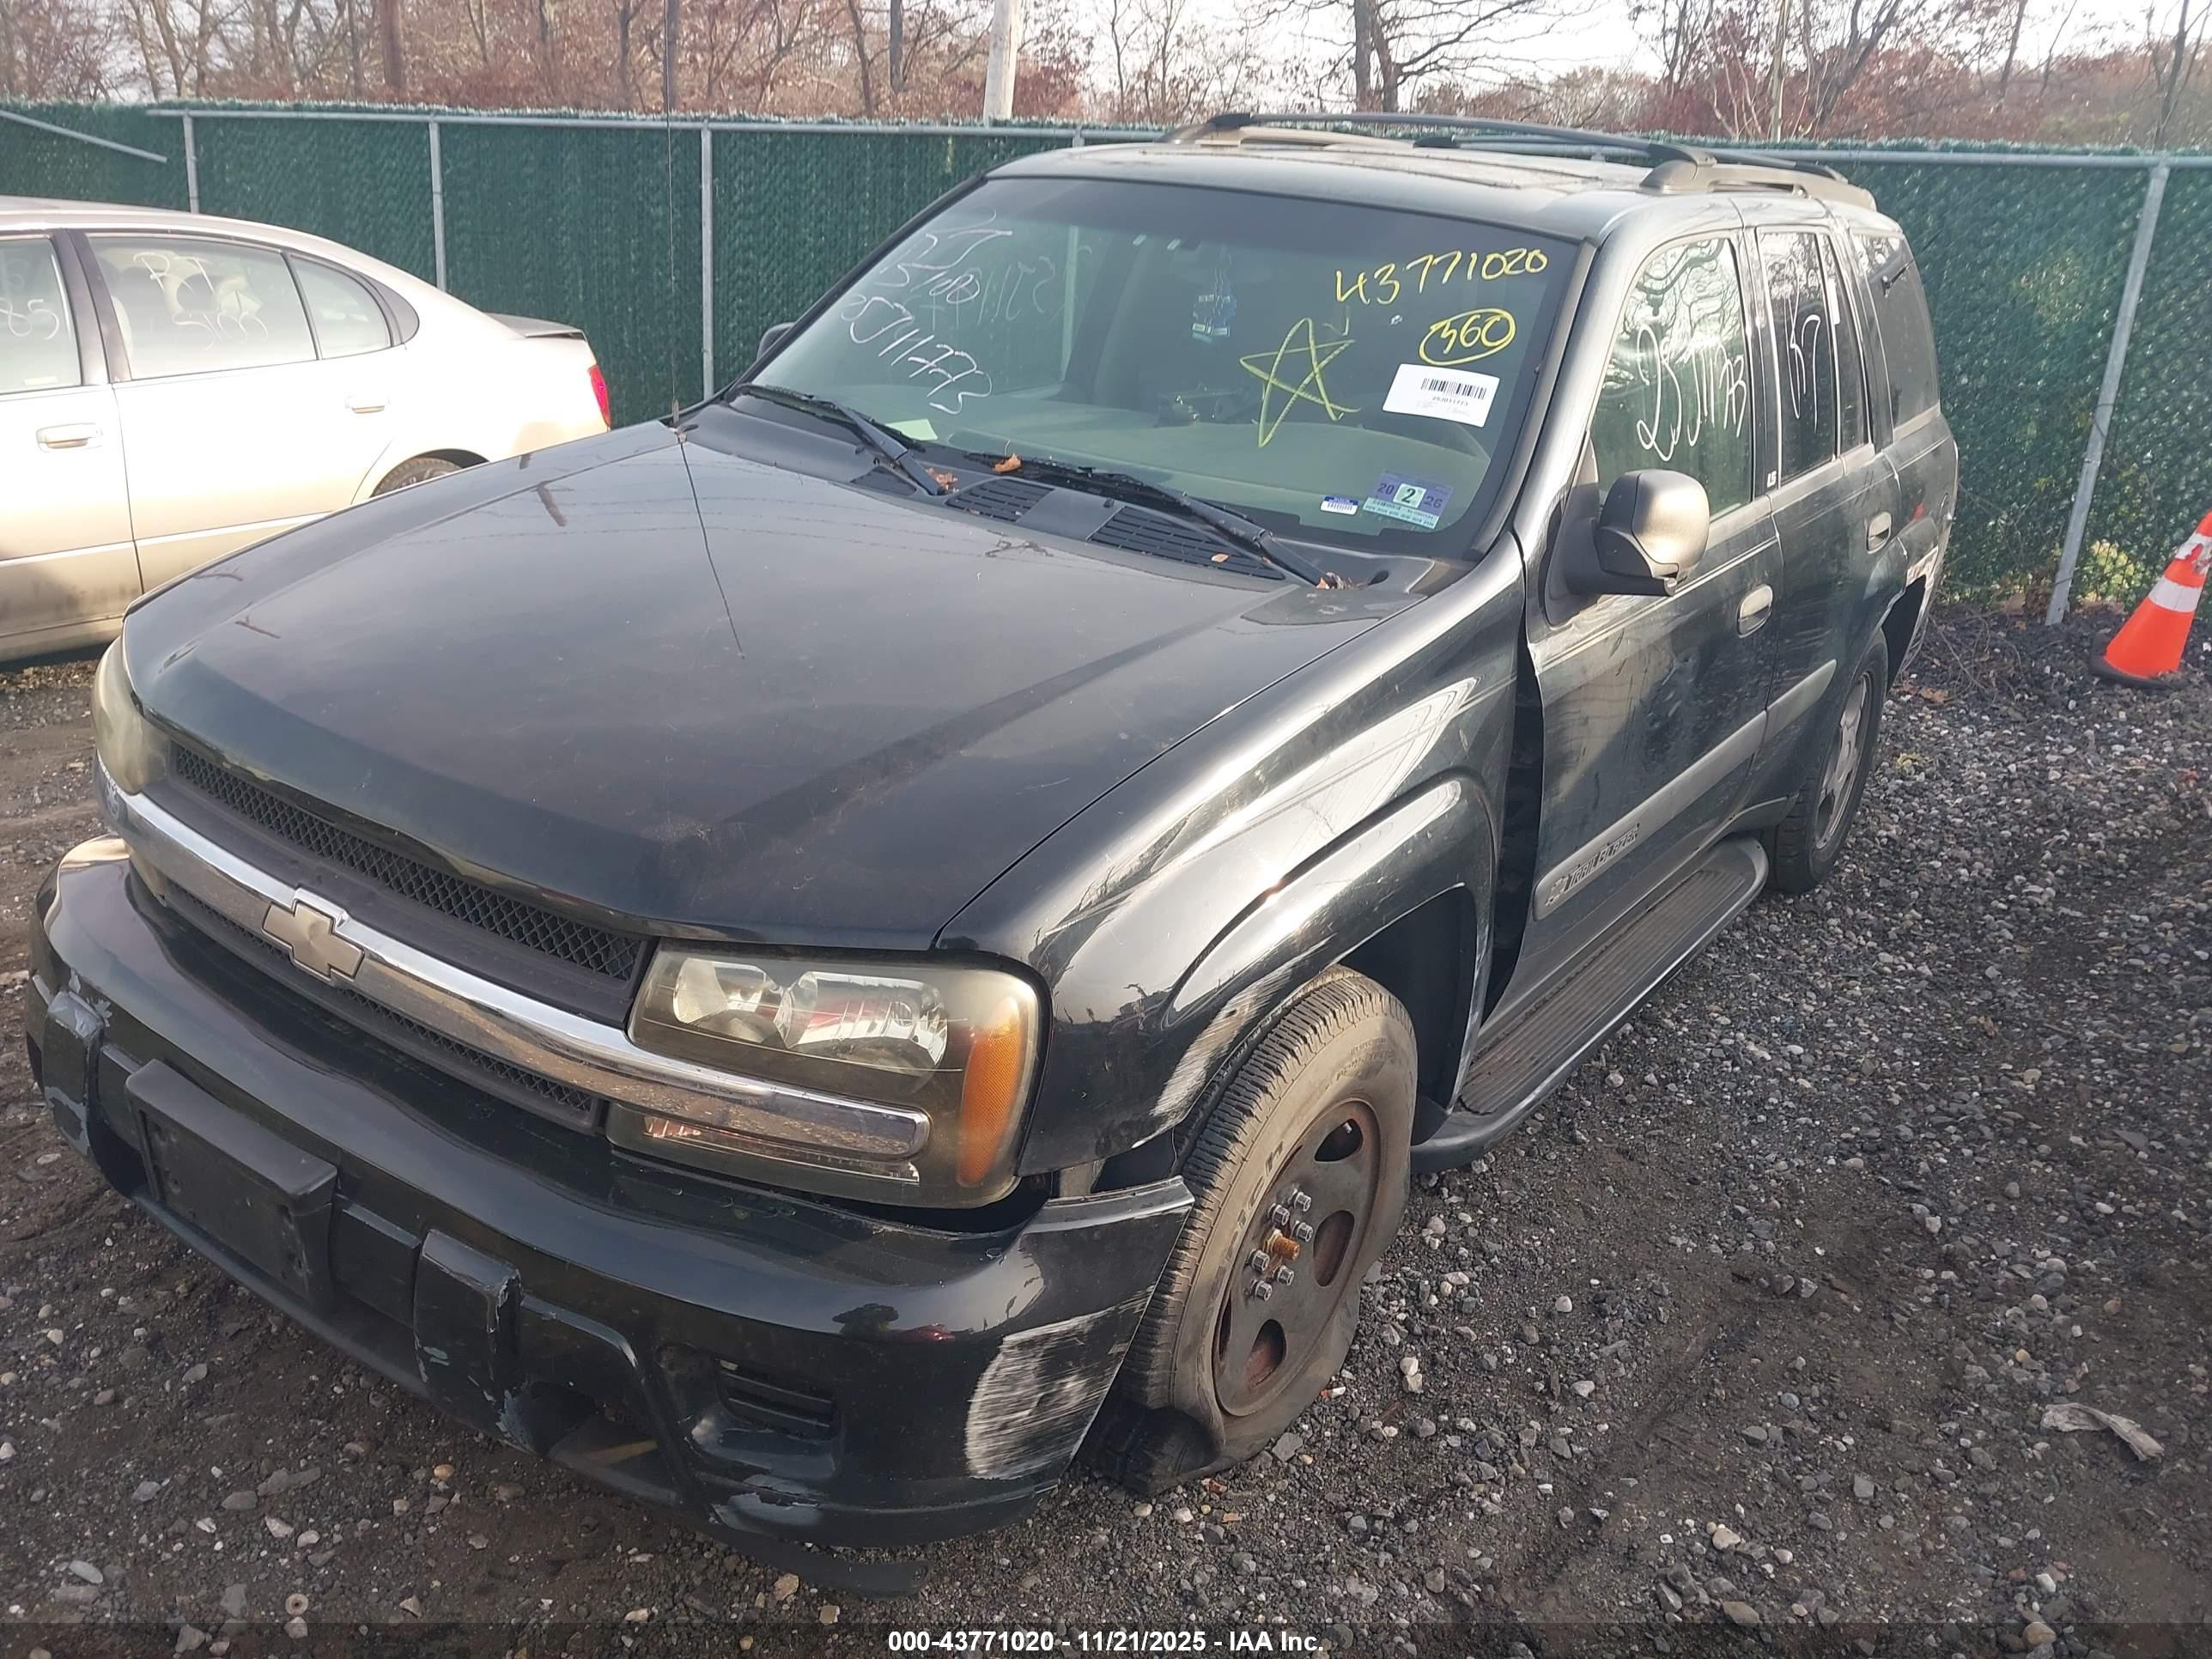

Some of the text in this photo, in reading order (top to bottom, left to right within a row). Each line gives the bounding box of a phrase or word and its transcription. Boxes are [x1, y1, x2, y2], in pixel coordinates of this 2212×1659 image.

[1335, 248, 1547, 305] 43771020
[1377, 483, 1443, 509] 20 2 26
